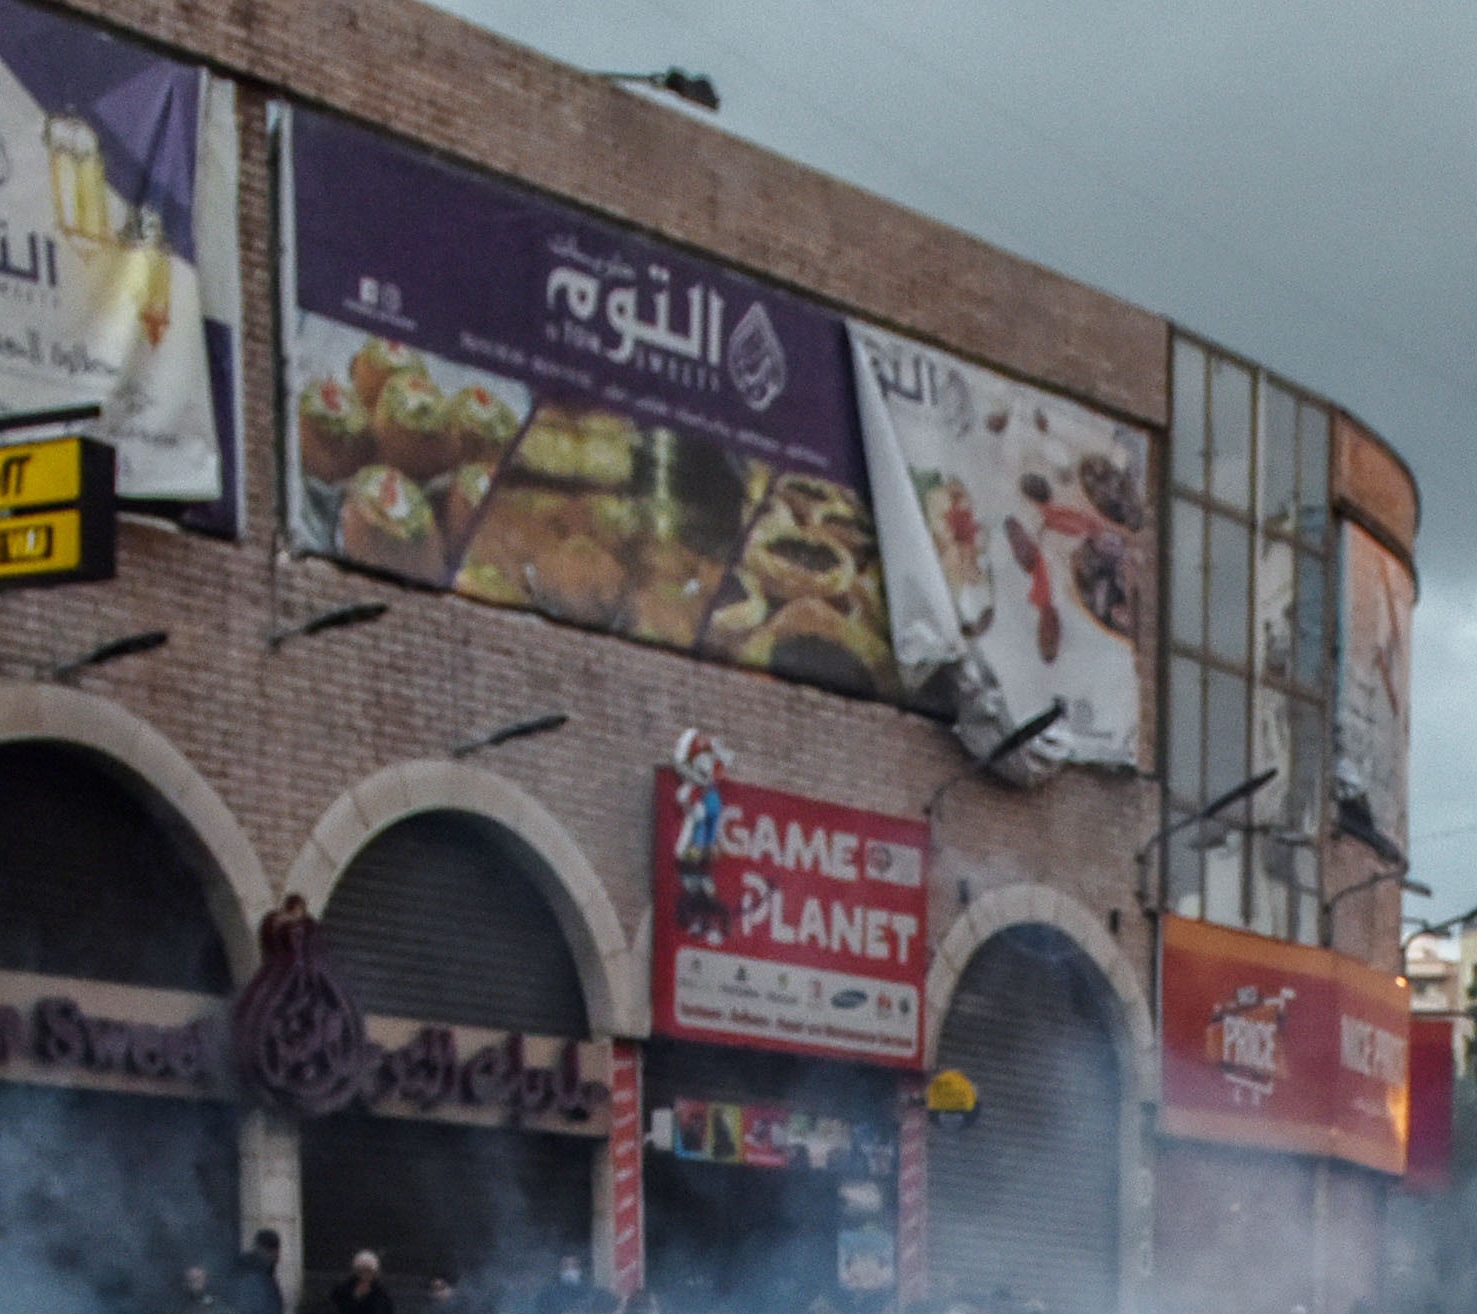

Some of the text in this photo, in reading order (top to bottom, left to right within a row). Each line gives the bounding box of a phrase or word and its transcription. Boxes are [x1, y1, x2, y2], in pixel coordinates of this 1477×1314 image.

[545, 263, 724, 366] التوم
[716, 805, 860, 882] GAME
[740, 871, 919, 963] PLANET
